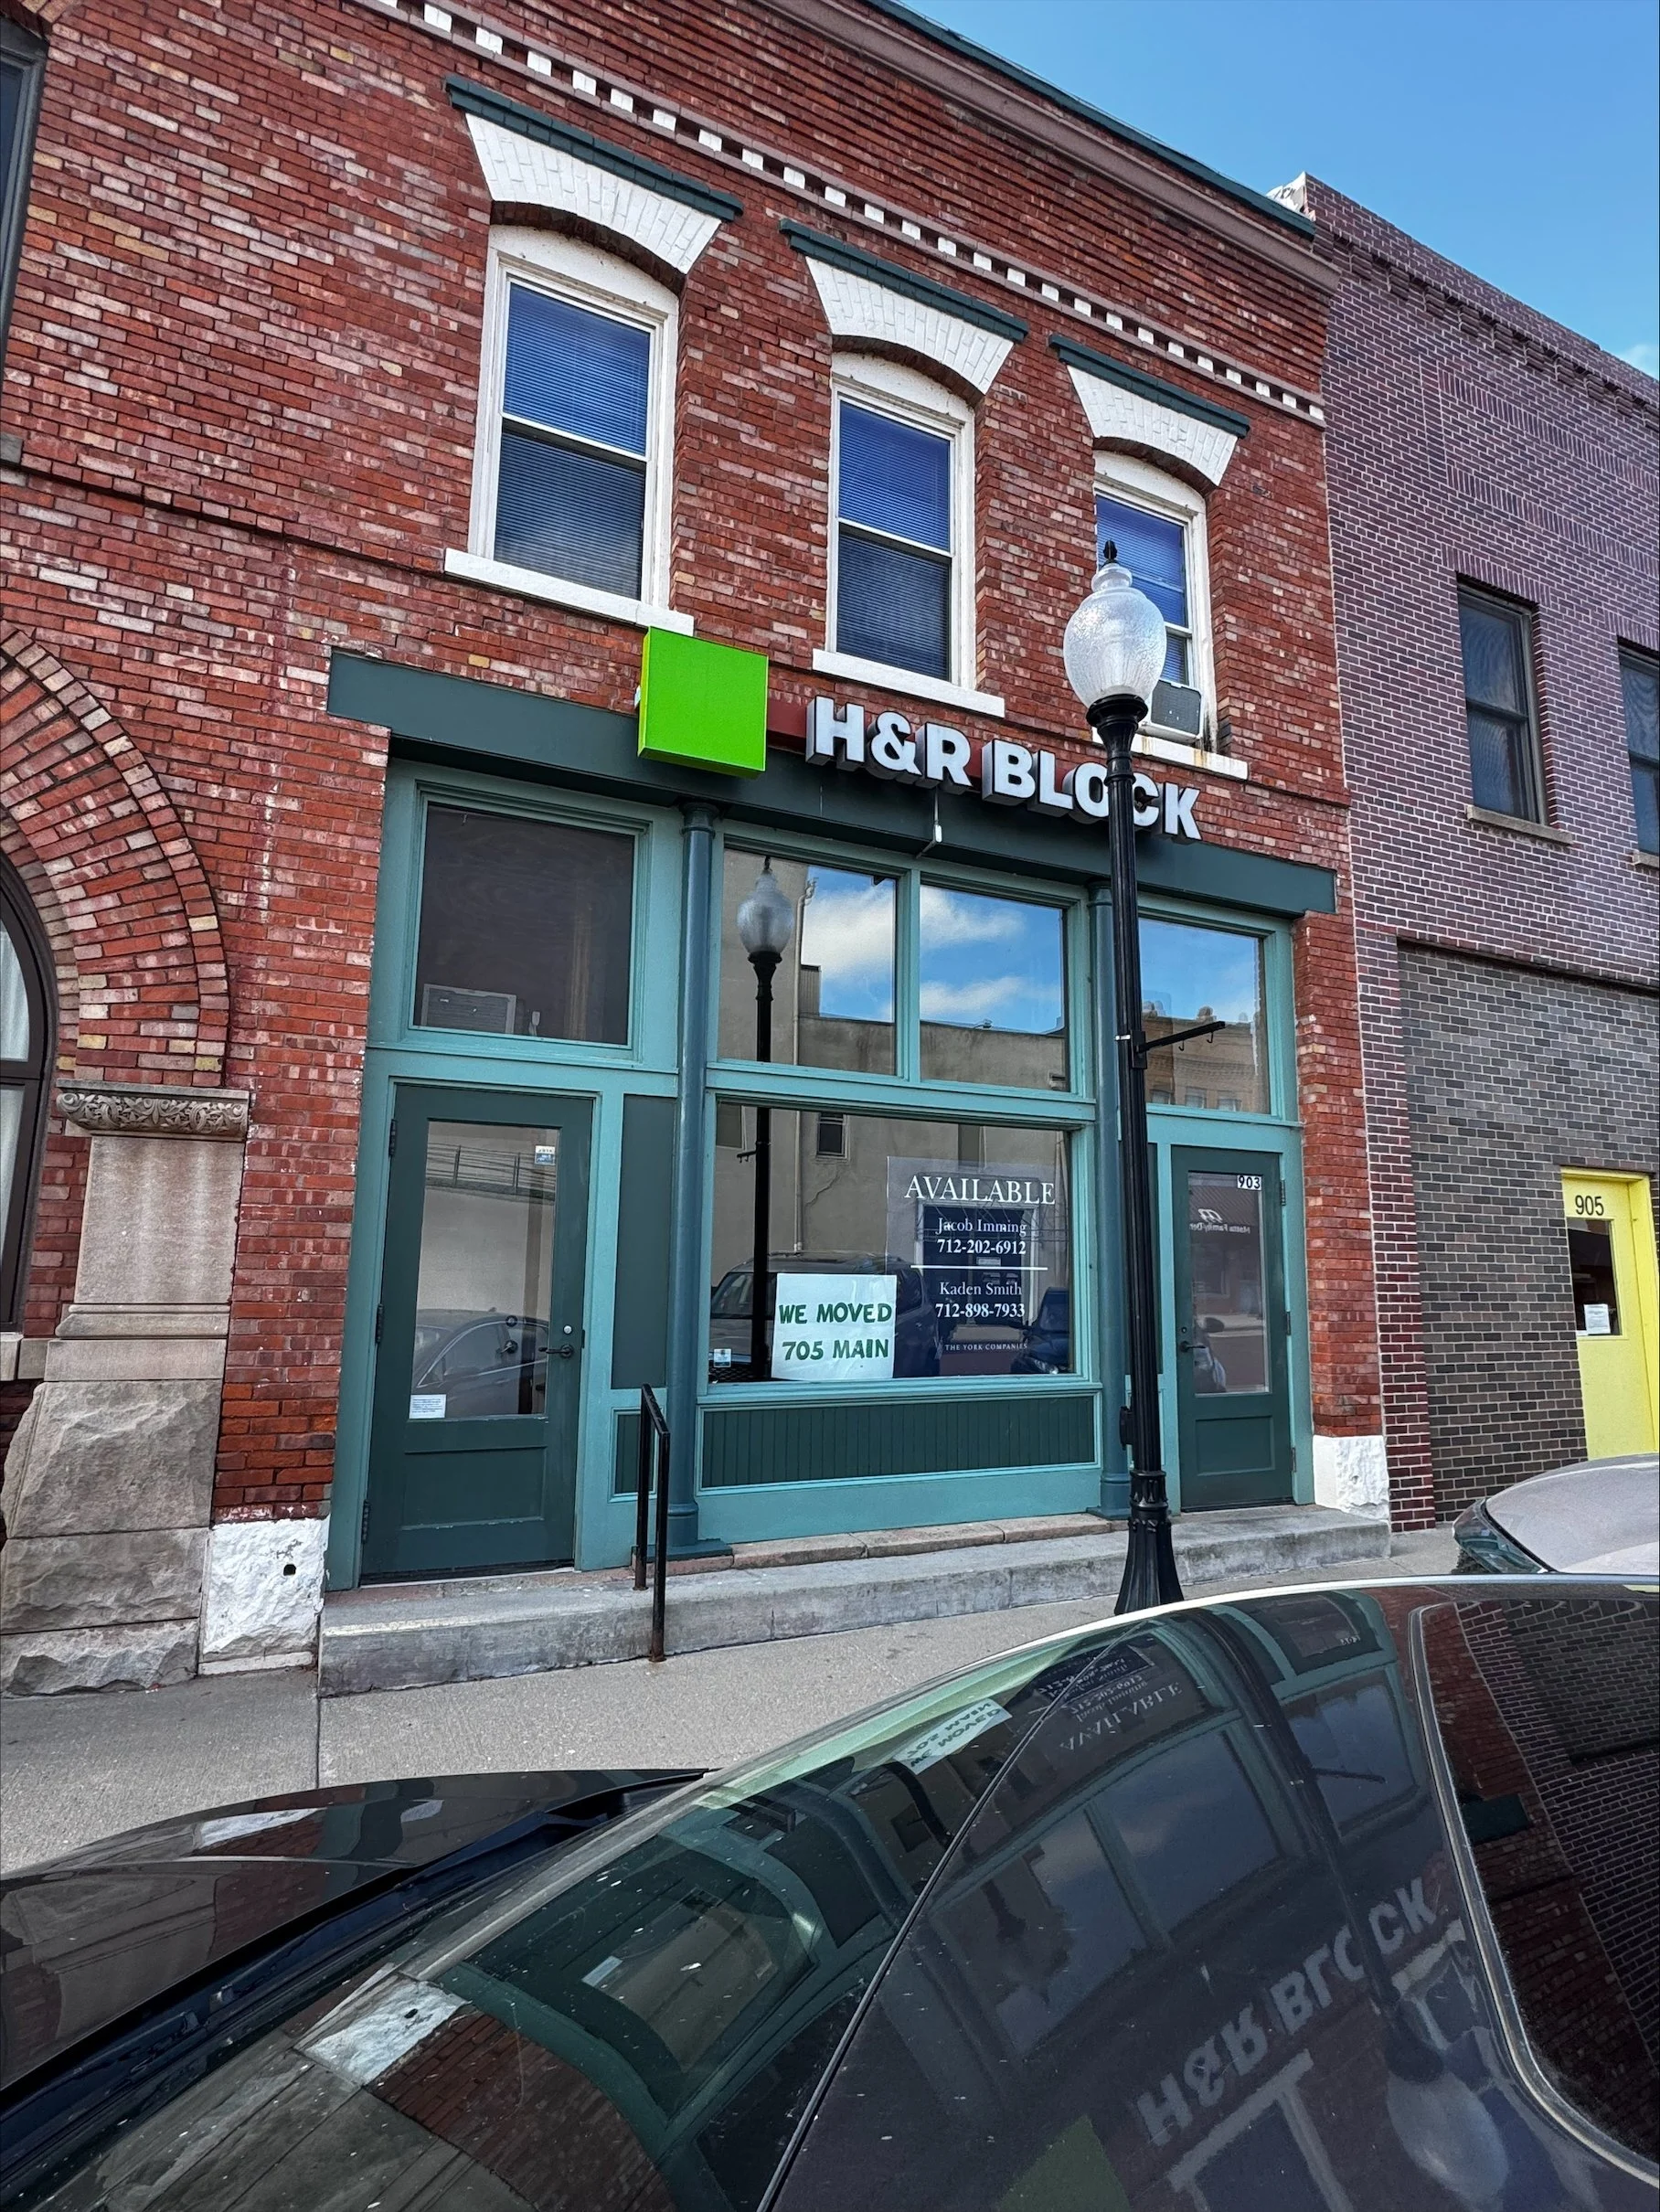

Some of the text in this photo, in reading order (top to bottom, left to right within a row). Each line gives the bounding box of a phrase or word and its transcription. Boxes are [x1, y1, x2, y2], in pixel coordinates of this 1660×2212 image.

[807, 695, 1202, 841] H&R BLOCK
[904, 1175, 1056, 1205] AVAILABLE
[1238, 1175, 1261, 1189] 903
[1575, 1195, 1604, 1216] 905
[935, 1218, 1027, 1237] Jacob Imming
[936, 1239, 1027, 1255] 712-202-6912
[939, 1281, 1023, 1296] Kaden Smith
[778, 1302, 892, 1324] WE MOVED
[935, 1303, 1026, 1318] 712-898-7933
[782, 1338, 889, 1361] 705 MAIN
[985, 1343, 1028, 1351] COMPANIES
